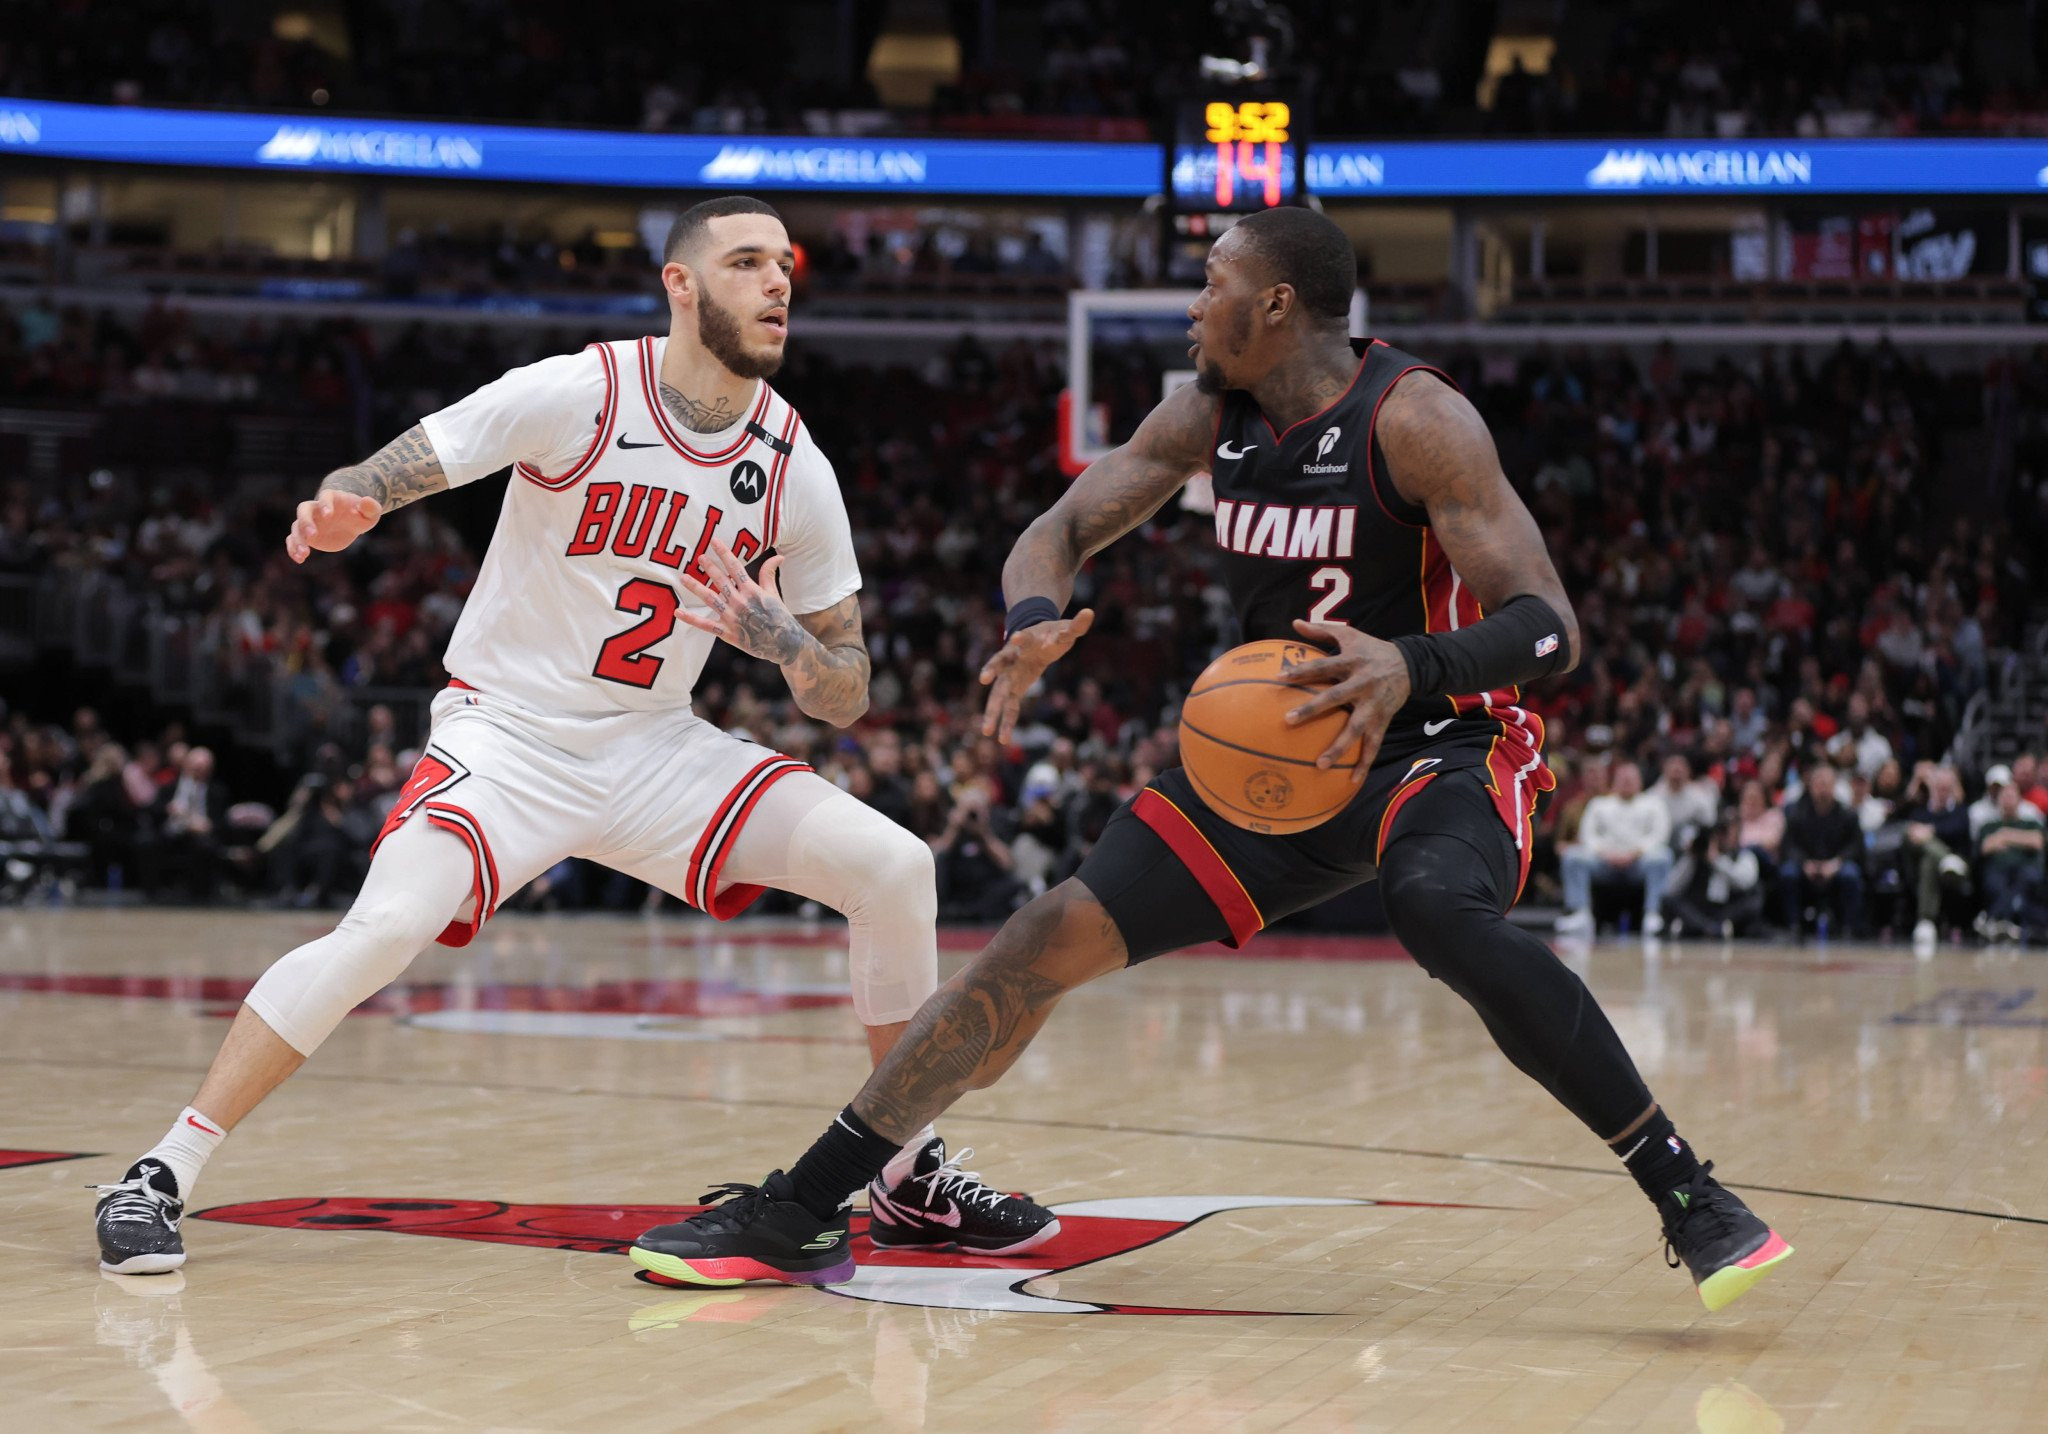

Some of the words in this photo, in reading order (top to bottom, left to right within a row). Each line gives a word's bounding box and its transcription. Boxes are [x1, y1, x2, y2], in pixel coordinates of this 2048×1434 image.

[1205, 101, 1291, 143] 9:52
[761, 147, 928, 184] MAGELLAN
[1216, 141, 1281, 207] 14
[1642, 150, 1812, 185] MAGELLAN
[763, 432, 775, 447] 10
[1302, 462, 1349, 474] Robinhood
[1308, 564, 1351, 627] 2
[592, 577, 680, 690] 2
